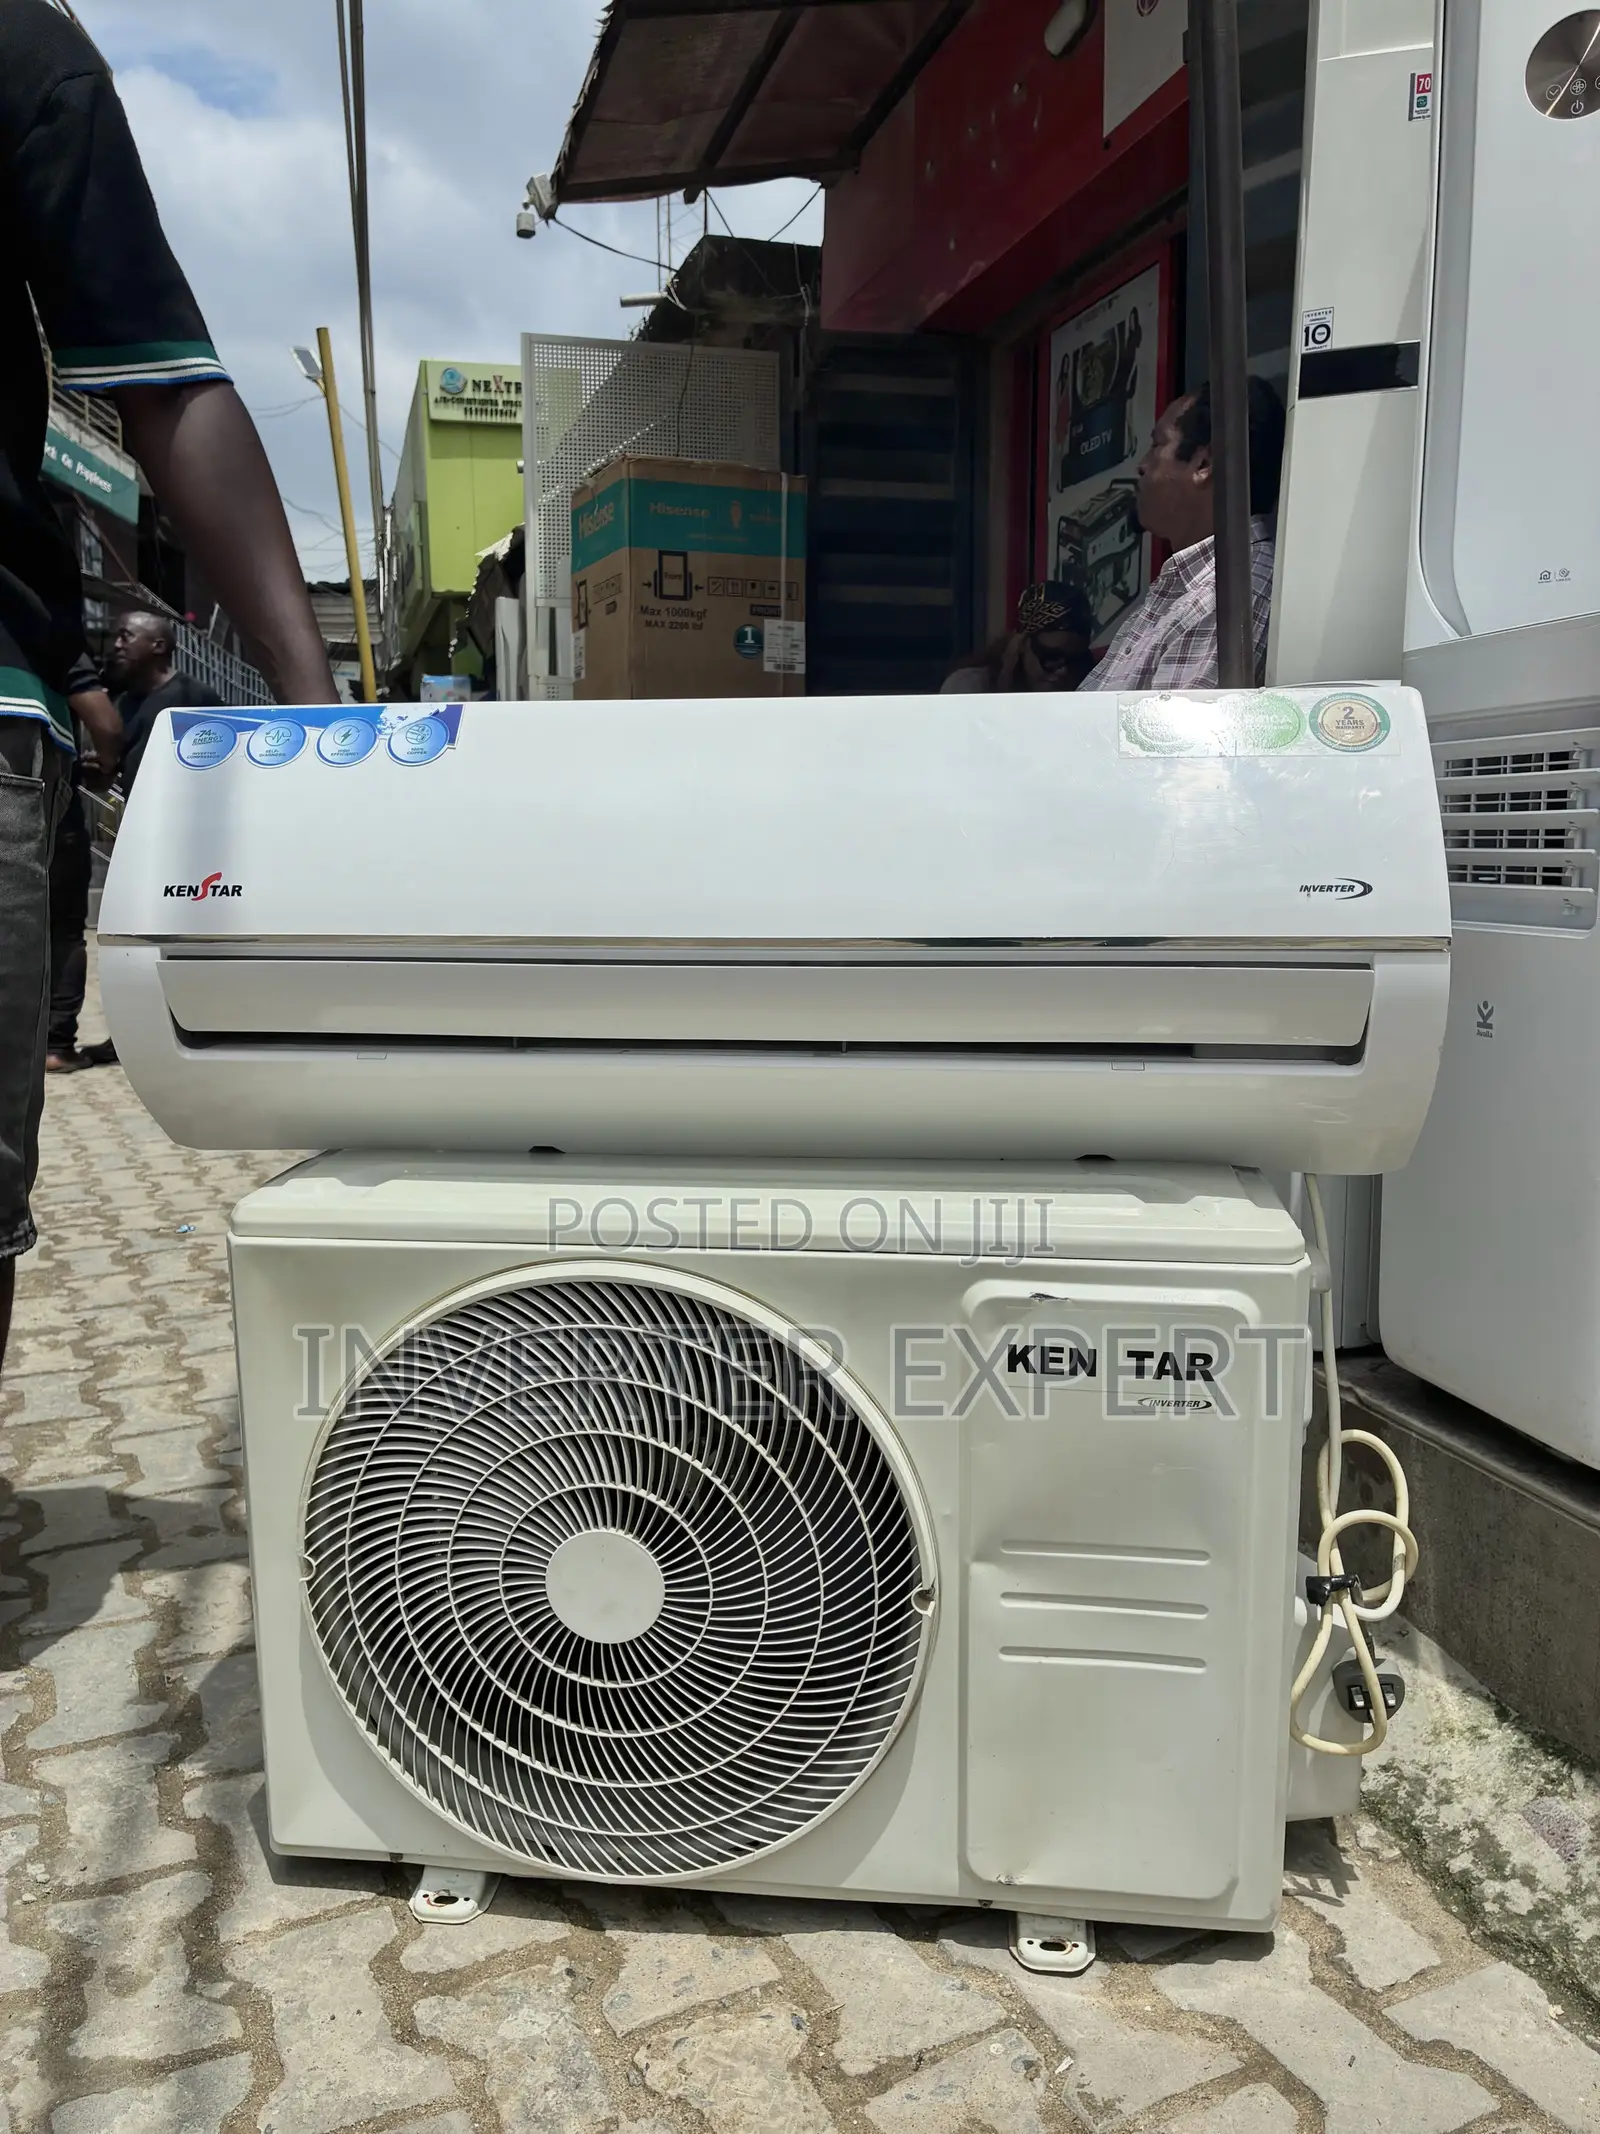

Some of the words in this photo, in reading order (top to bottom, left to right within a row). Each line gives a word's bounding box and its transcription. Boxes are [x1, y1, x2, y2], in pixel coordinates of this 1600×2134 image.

[1418, 77, 1431, 91] 70
[1304, 323, 1331, 347] 10
[1080, 435, 1100, 455] OLED
[1101, 428, 1113, 445] TV
[648, 500, 711, 519] Hisense
[639, 605, 661, 617] Max
[665, 606, 708, 620] 1000kgf
[744, 627, 755, 644] 1
[1342, 706, 1355, 720] 2
[192, 735, 224, 744] ENERGY
[163, 872, 243, 902] KENSTAR
[1299, 884, 1356, 893] INVERTER
[1149, 1399, 1201, 1409] INVERTER
